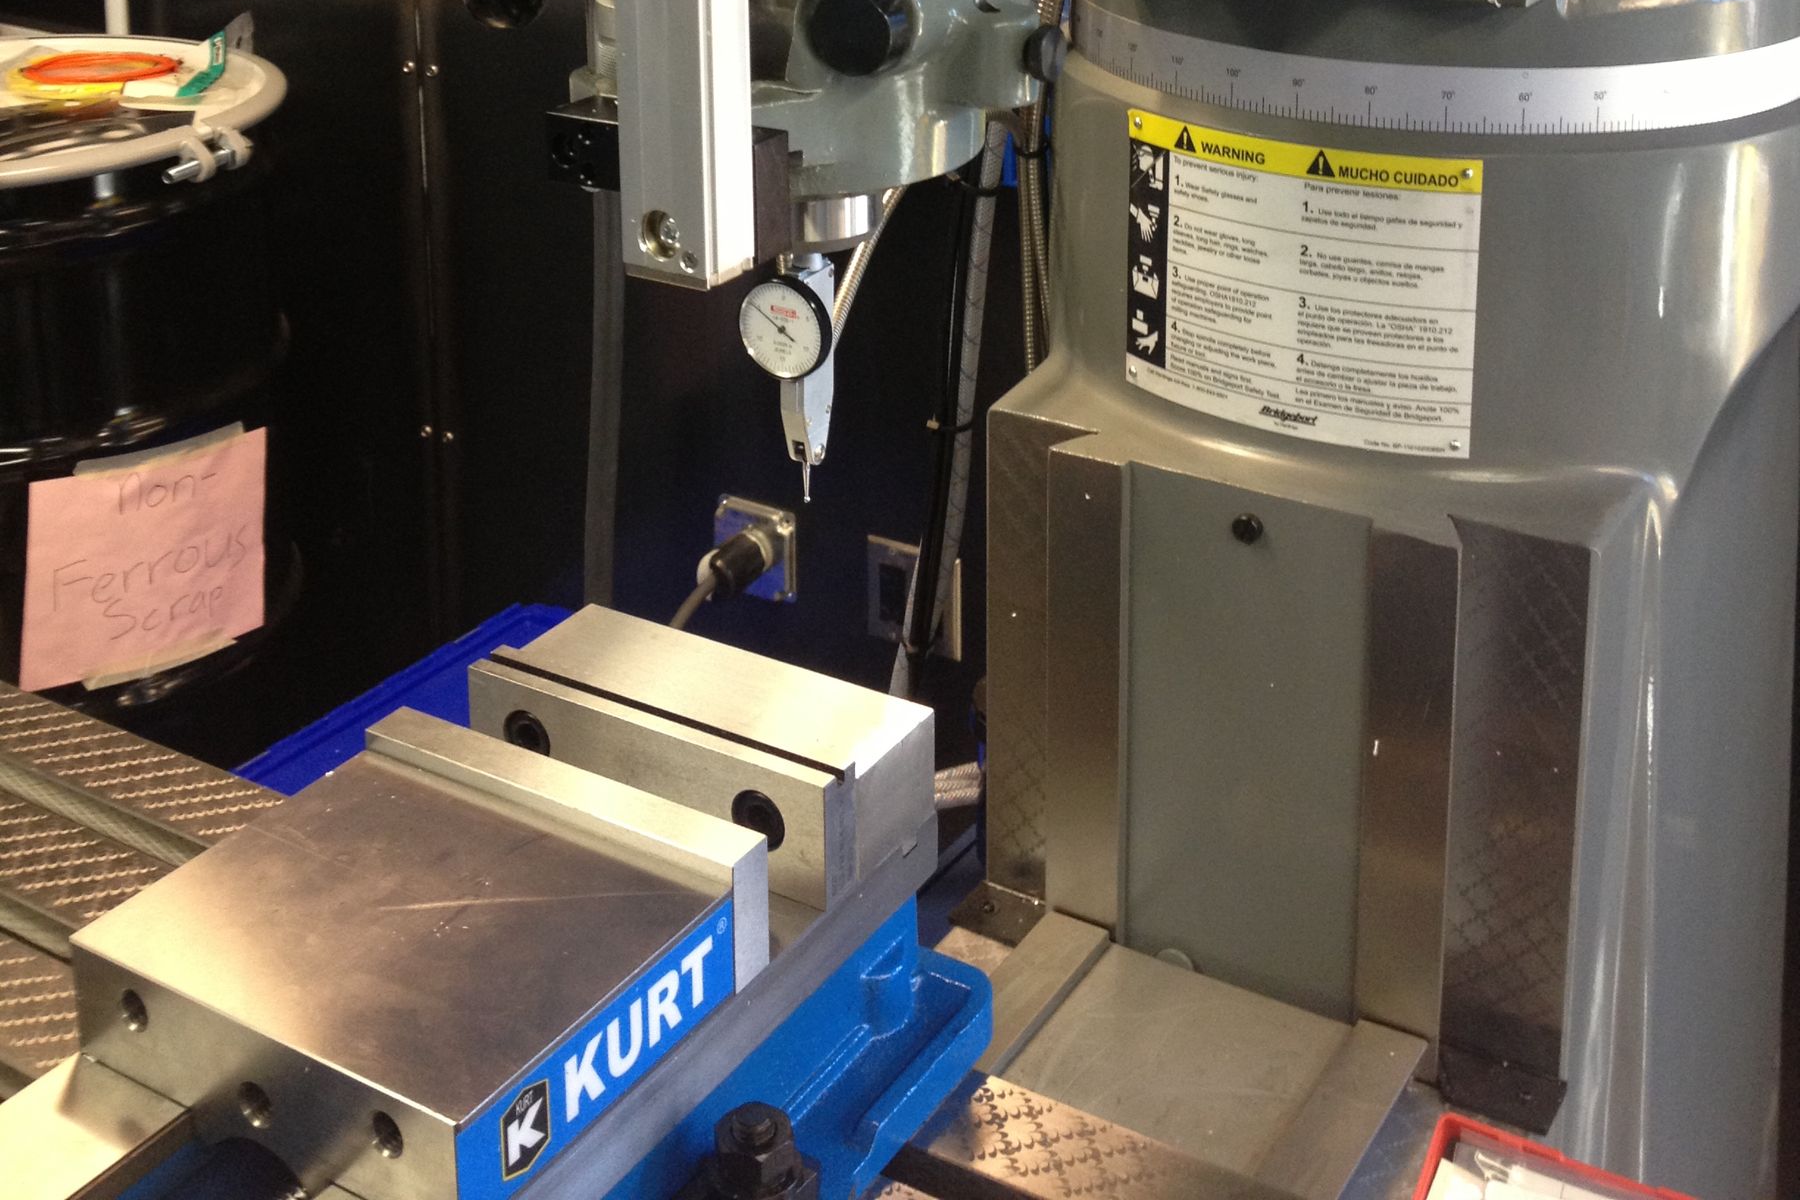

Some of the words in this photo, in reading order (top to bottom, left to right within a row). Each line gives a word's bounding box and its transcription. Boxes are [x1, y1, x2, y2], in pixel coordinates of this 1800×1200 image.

[1201, 141, 1265, 165] WARNING
[1183, 158, 1207, 171] prevent
[1209, 165, 1234, 177] serious
[1338, 166, 1389, 182] MUCHO
[1394, 171, 1459, 188] CUIDADO
[1175, 175, 1184, 186] 1.
[1202, 185, 1220, 197] Safety
[1221, 191, 1244, 202] glasses
[1246, 194, 1257, 204] and
[1304, 182, 1324, 192] Para
[1326, 185, 1360, 197] prevenir
[1173, 216, 1183, 228] 2.
[1194, 224, 1202, 233] not
[1302, 201, 1313, 213] 1.
[1318, 208, 1332, 217] Use
[1334, 210, 1349, 219] todo
[1351, 212, 1358, 220] el
[1360, 213, 1384, 223] tiempo
[1408, 217, 1418, 226] de
[1420, 219, 1456, 229] seguridad
[1330, 219, 1339, 227] de
[1300, 245, 1312, 257] 2.
[1317, 252, 1327, 260] No
[1403, 262, 1413, 270] de
[1172, 266, 1181, 280] 3.
[1299, 296, 1310, 309] 3.
[1171, 321, 1181, 333] 4.
[1297, 353, 1308, 365] 4.
[53, 523, 249, 612] Ferrous
[103, 586, 223, 640] Scrap
[564, 934, 713, 1123] KURT
[515, 1090, 534, 1116] KURT
[507, 1097, 546, 1167] K
